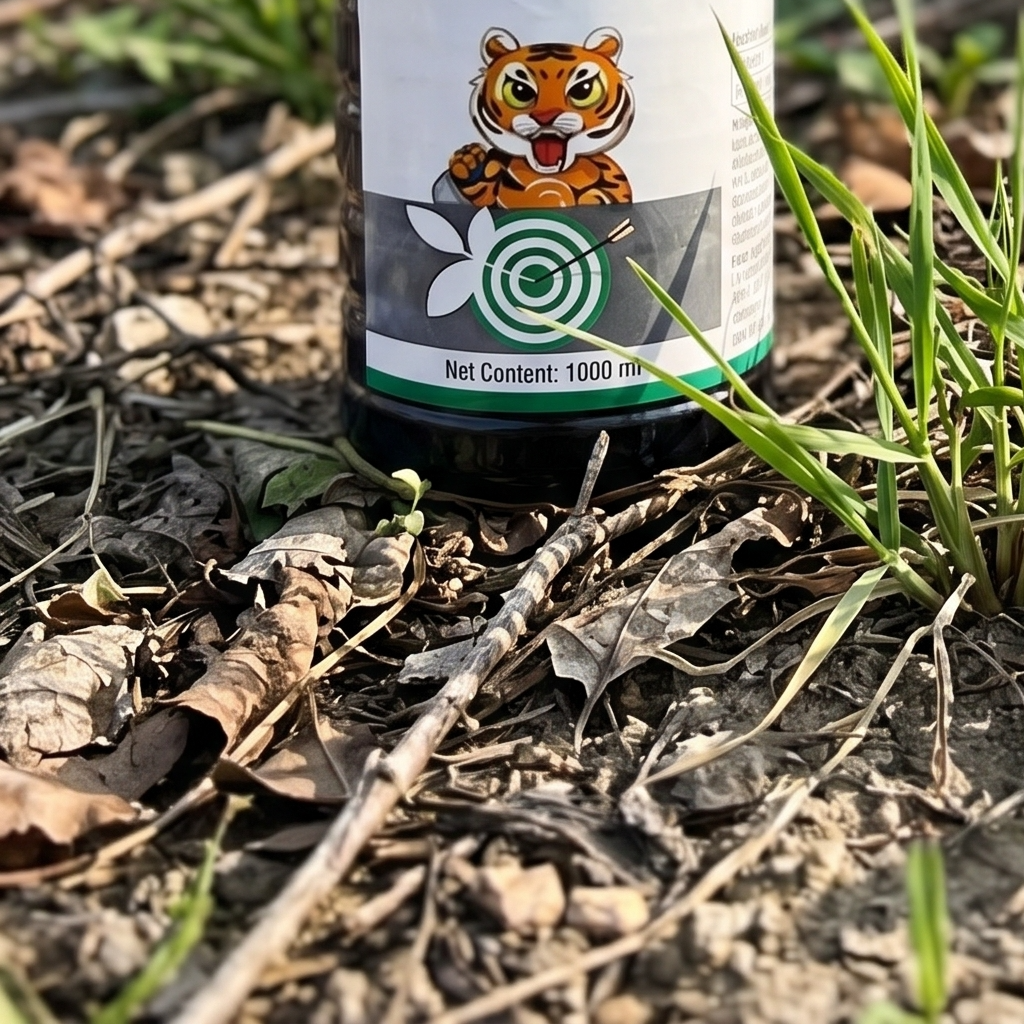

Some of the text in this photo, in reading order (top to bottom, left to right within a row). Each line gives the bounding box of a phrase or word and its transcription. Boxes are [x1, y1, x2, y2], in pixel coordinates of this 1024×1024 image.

[445, 359, 476, 381] Net
[481, 362, 559, 383] Content:
[566, 360, 613, 382] 1000
